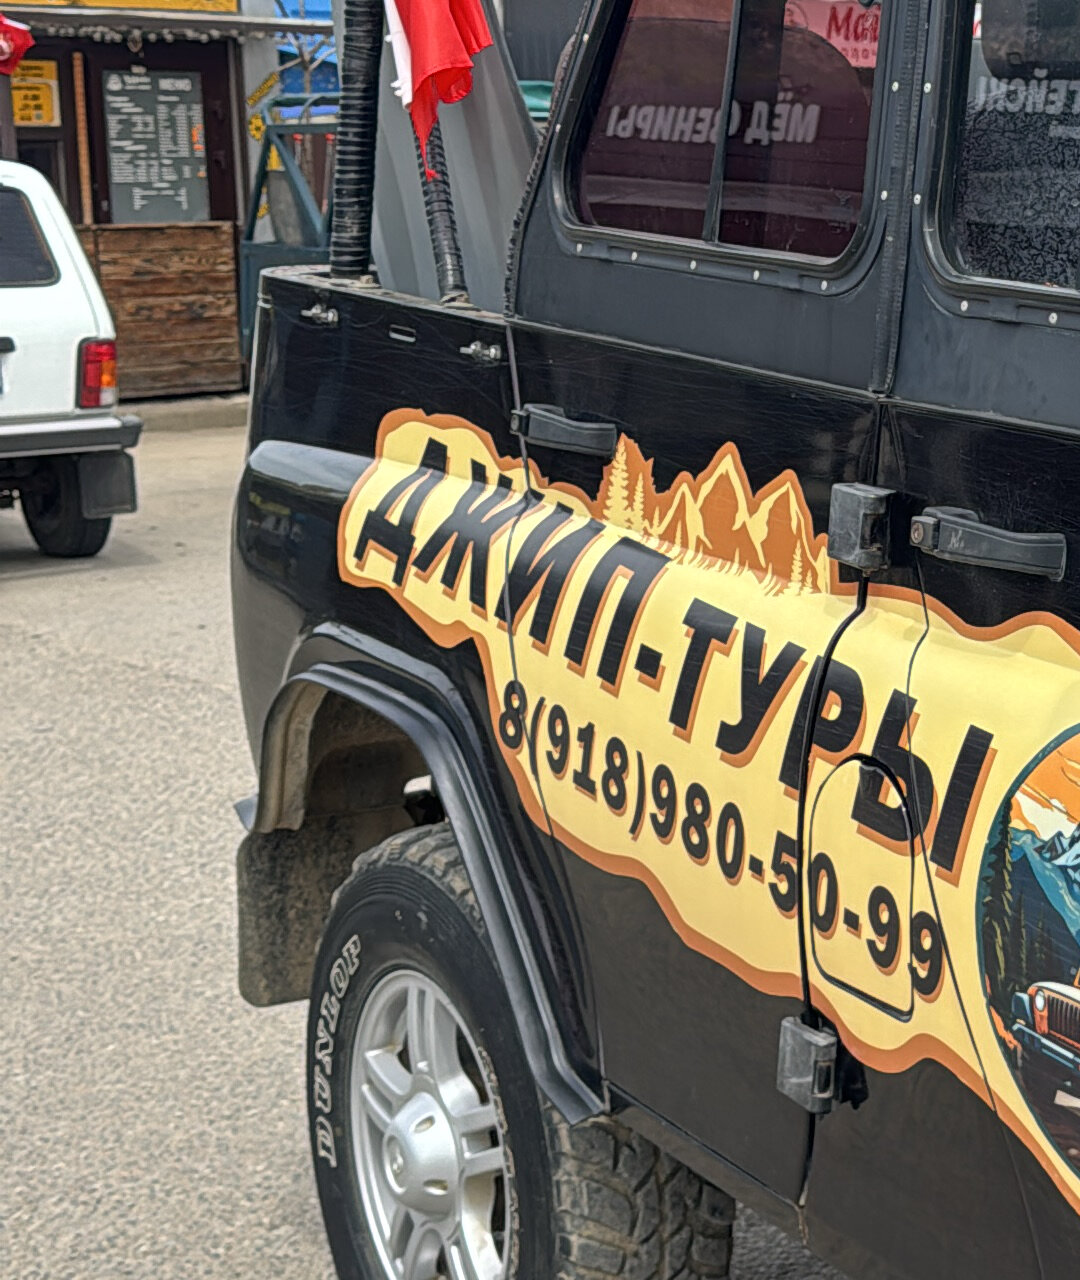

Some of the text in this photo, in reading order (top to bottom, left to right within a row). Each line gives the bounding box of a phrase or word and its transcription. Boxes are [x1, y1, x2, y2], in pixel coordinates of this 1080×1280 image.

[354, 437, 996, 884] ДЖИП-ТУРЫ
[499, 680, 946, 1001] 8(918)980-50-99
[314, 934, 361, 1168] DUNLOP
